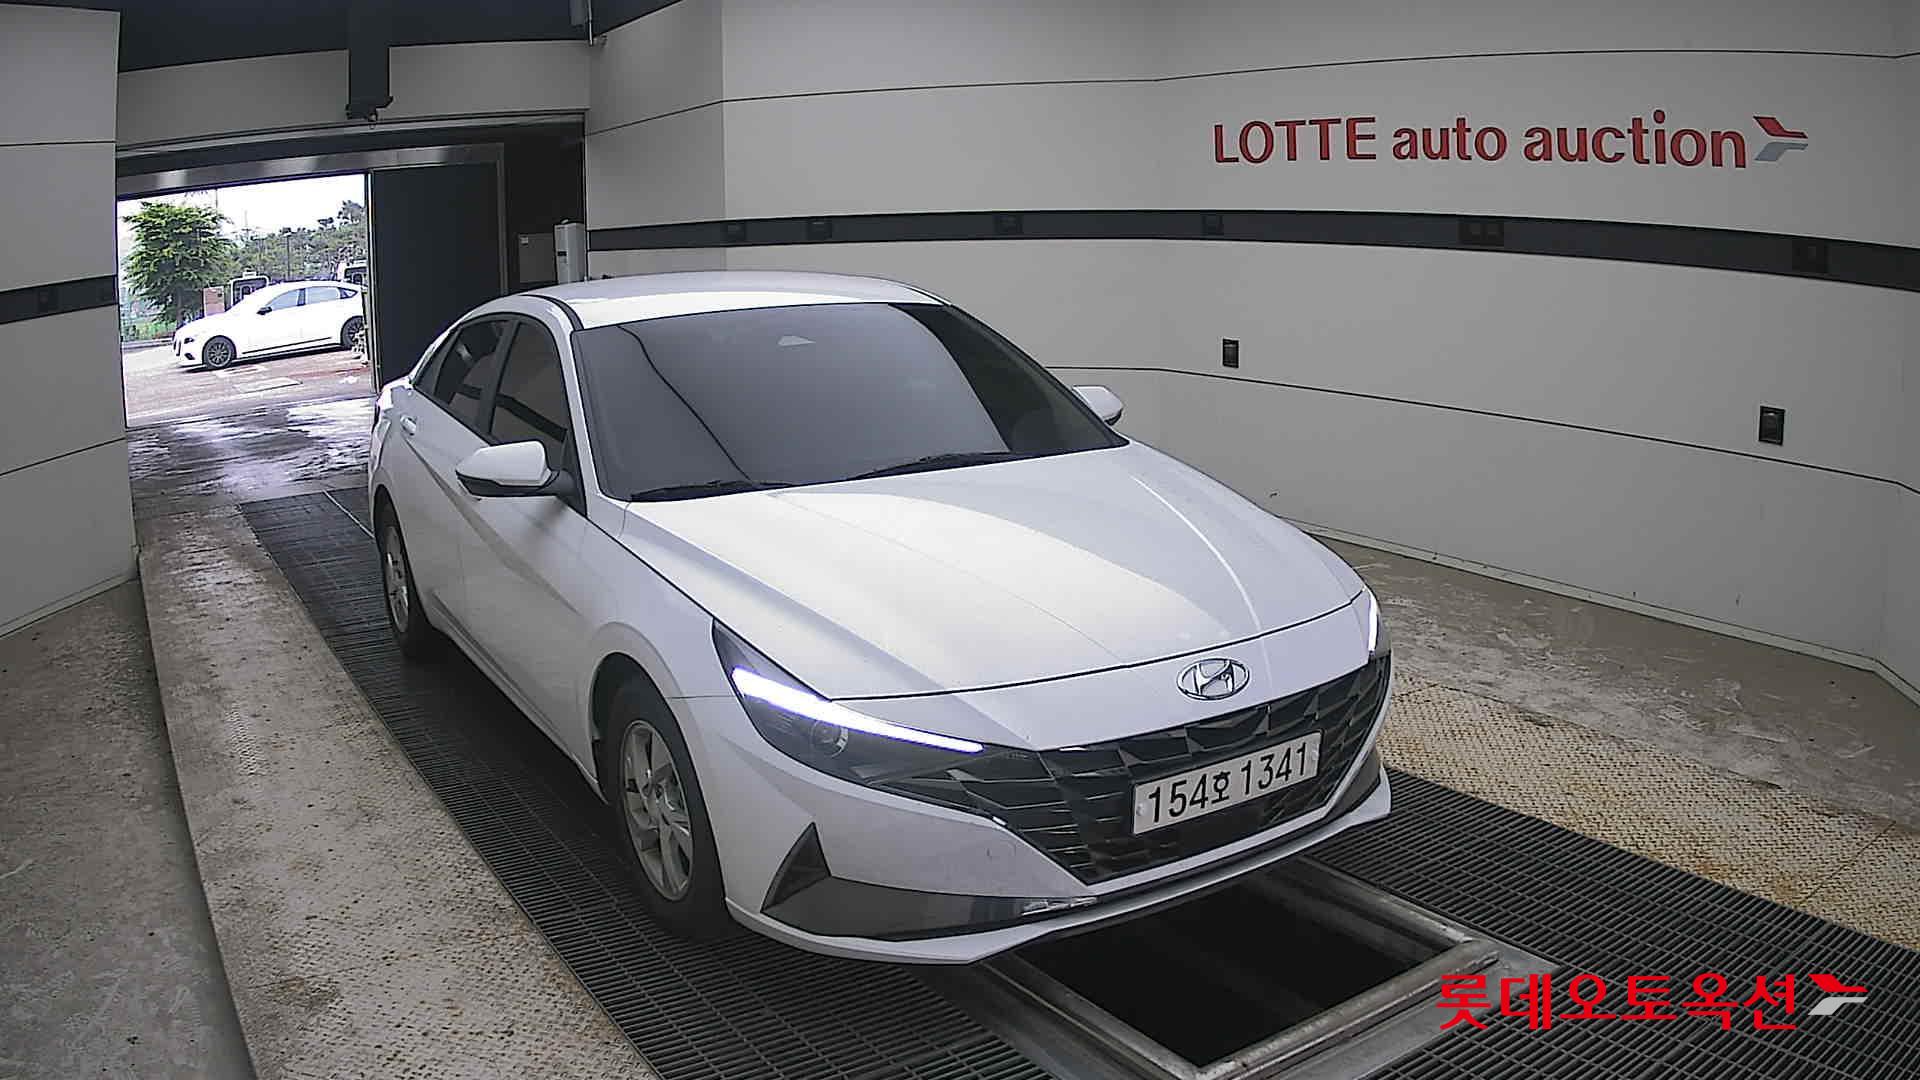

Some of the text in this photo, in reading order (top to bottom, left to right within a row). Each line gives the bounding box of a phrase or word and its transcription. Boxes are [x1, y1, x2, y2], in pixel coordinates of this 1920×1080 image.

[1213, 109, 1747, 169] LOTTE auto auction
[1240, 741, 1307, 796] 1341
